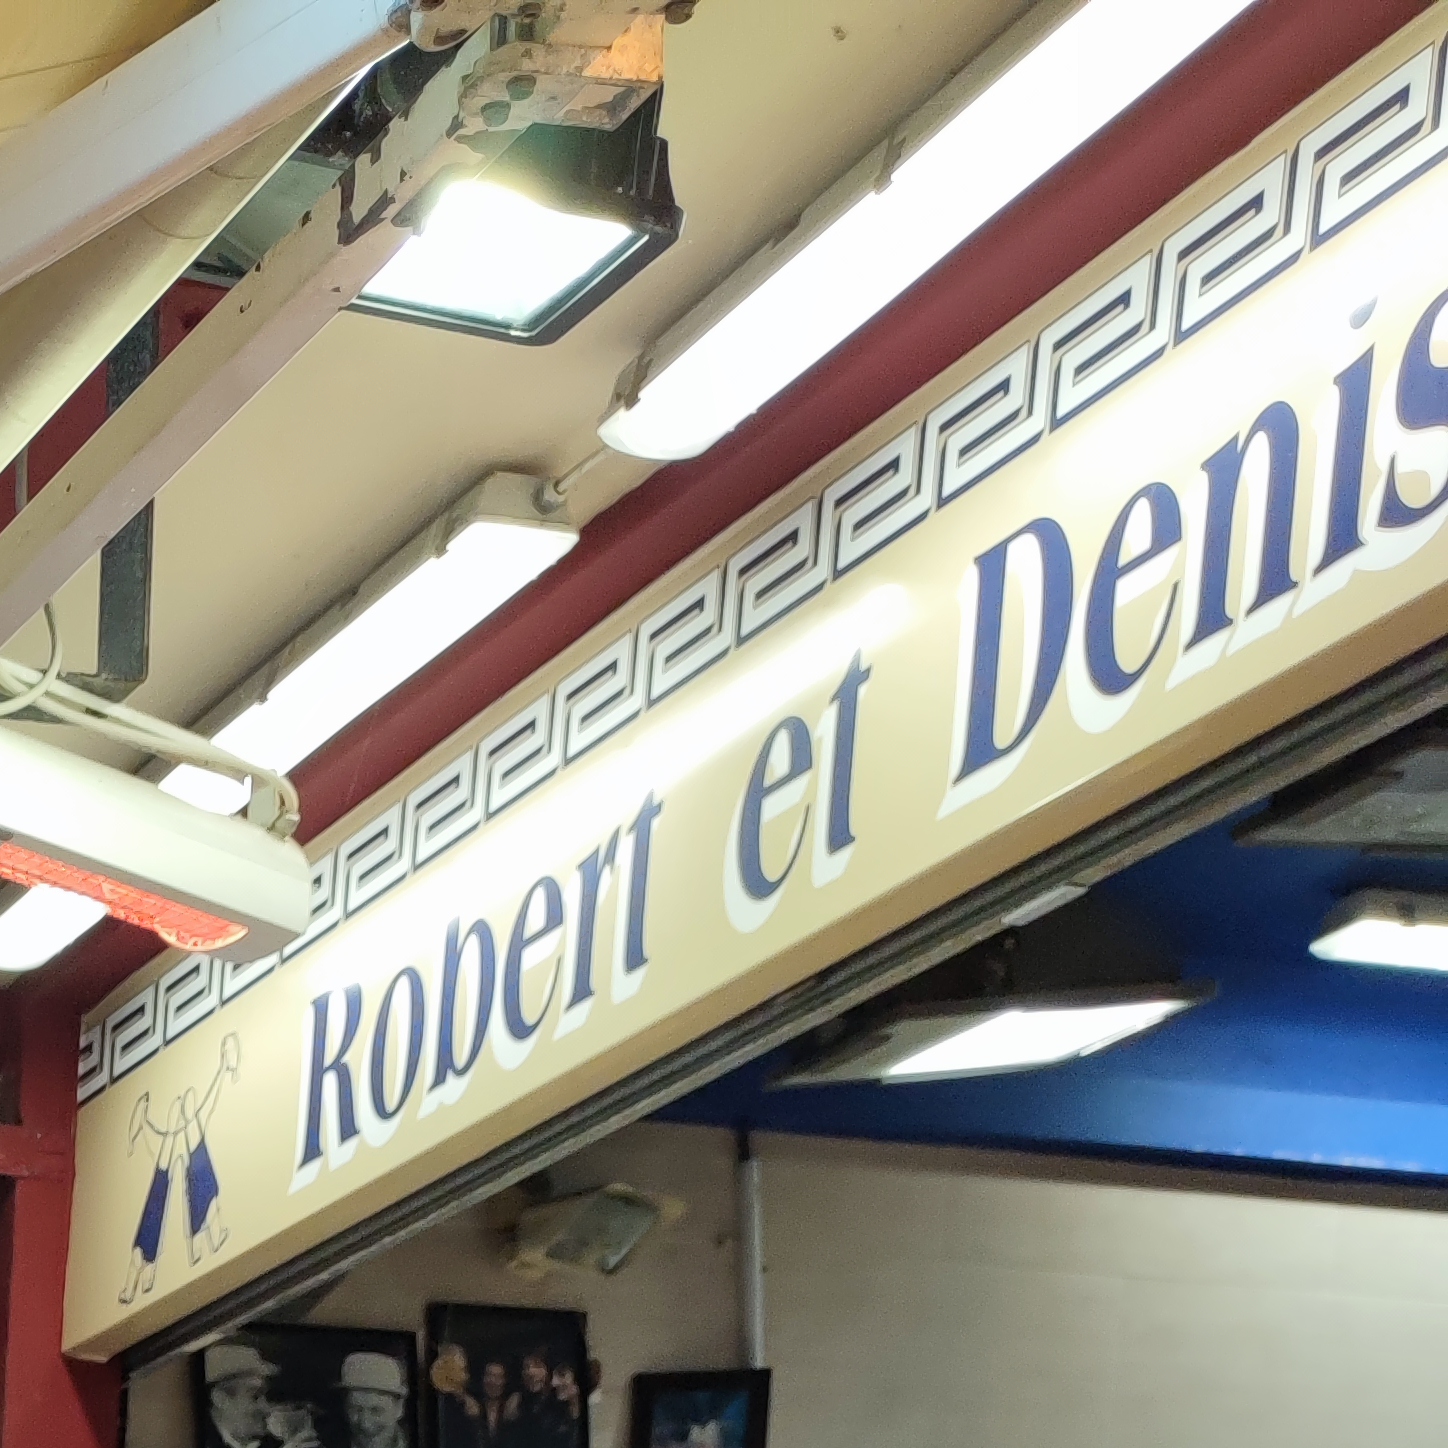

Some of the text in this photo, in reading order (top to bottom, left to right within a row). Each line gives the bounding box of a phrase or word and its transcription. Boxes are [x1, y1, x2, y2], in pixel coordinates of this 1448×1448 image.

[295, 288, 1448, 1173] Robert et Denis
